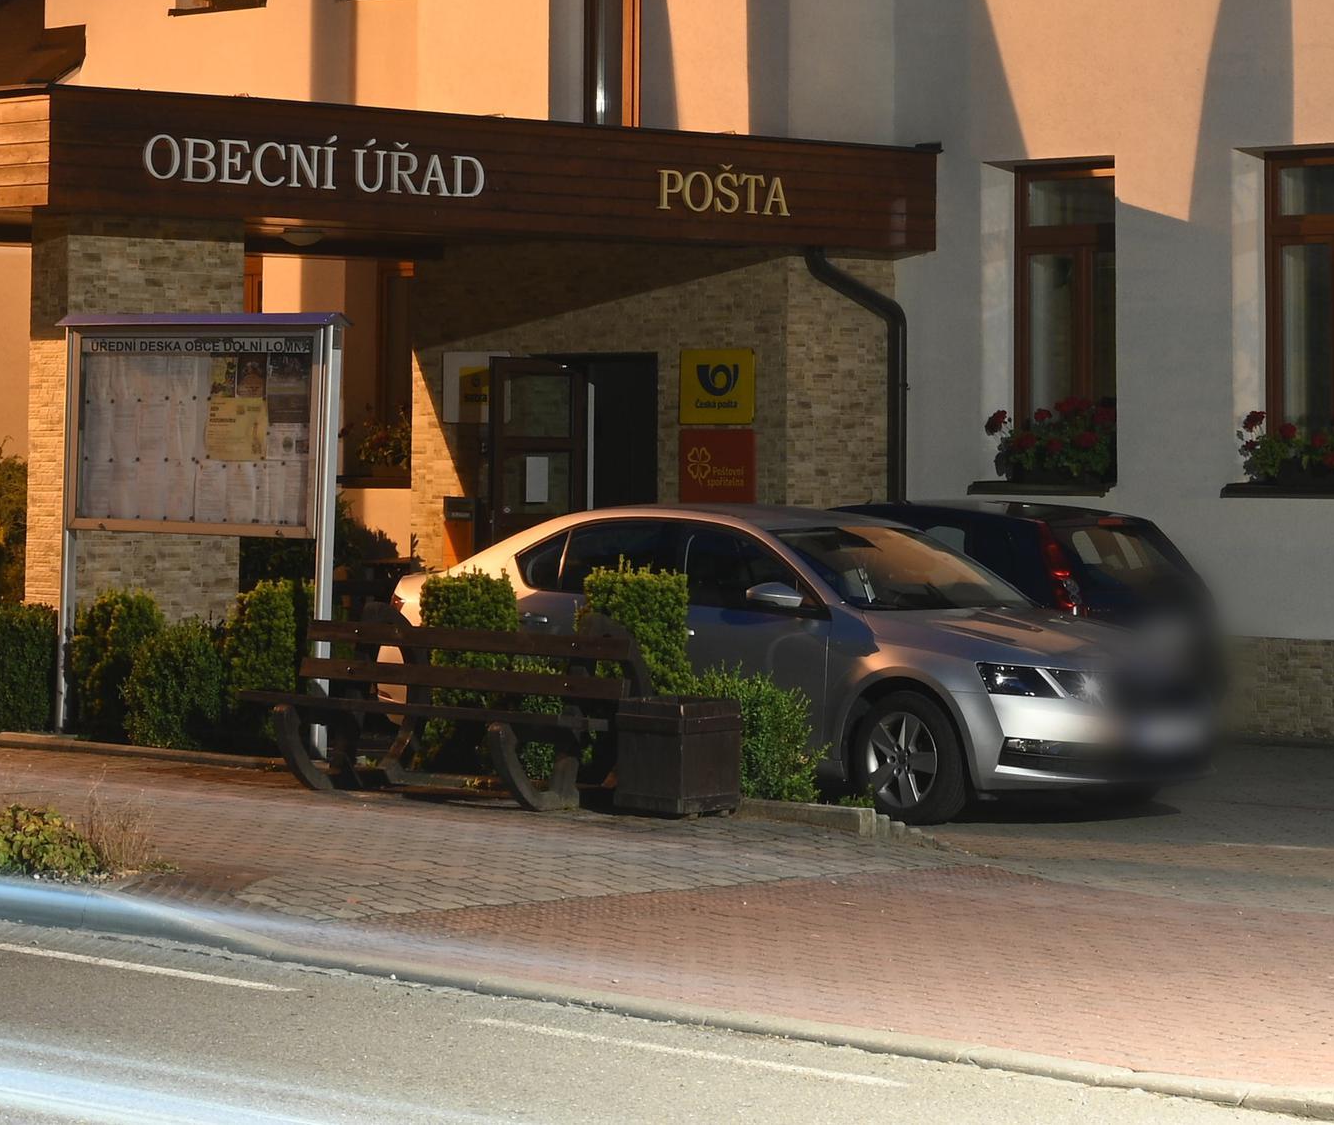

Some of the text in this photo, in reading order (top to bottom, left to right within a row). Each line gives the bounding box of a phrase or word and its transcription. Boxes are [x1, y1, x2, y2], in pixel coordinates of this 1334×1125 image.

[143, 134, 485, 198] OBECNÍ ÚŘAD
[656, 163, 791, 217] POŠTA
[139, 340, 182, 352] DESKA
[184, 340, 220, 352] OBCE
[223, 338, 262, 352] DOLNÍ
[695, 399, 737, 410] Česká pošta
[712, 466, 744, 476] Poštovní
